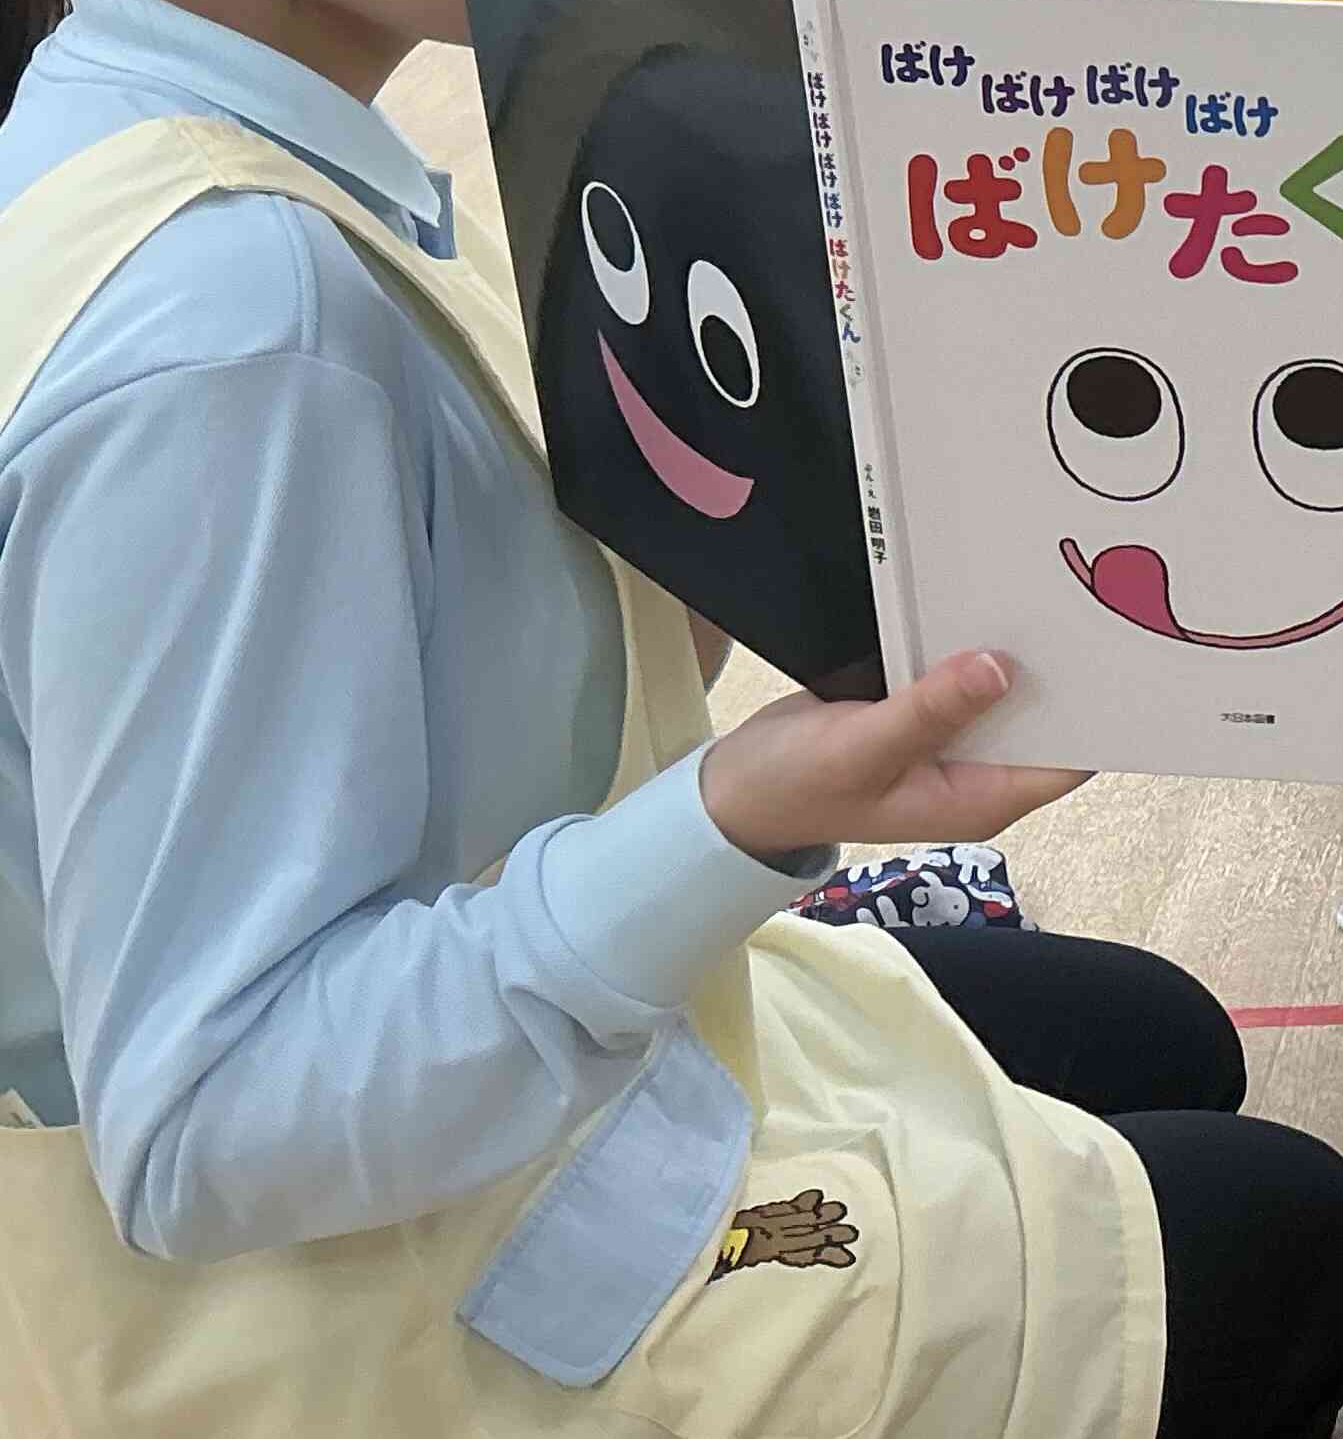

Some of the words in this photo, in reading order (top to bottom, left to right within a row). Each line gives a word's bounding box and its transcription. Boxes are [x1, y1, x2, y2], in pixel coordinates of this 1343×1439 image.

[807, 71, 827, 109] ばけ
[881, 41, 976, 87] ばけ
[981, 71, 1076, 118] ばけ
[1086, 61, 1181, 109] ばけ
[1185, 91, 1279, 138] ばけ
[812, 111, 833, 150] ばけ
[818, 153, 838, 189] ばけ
[823, 192, 843, 229] ばけ
[828, 239, 862, 345] ばけたくん
